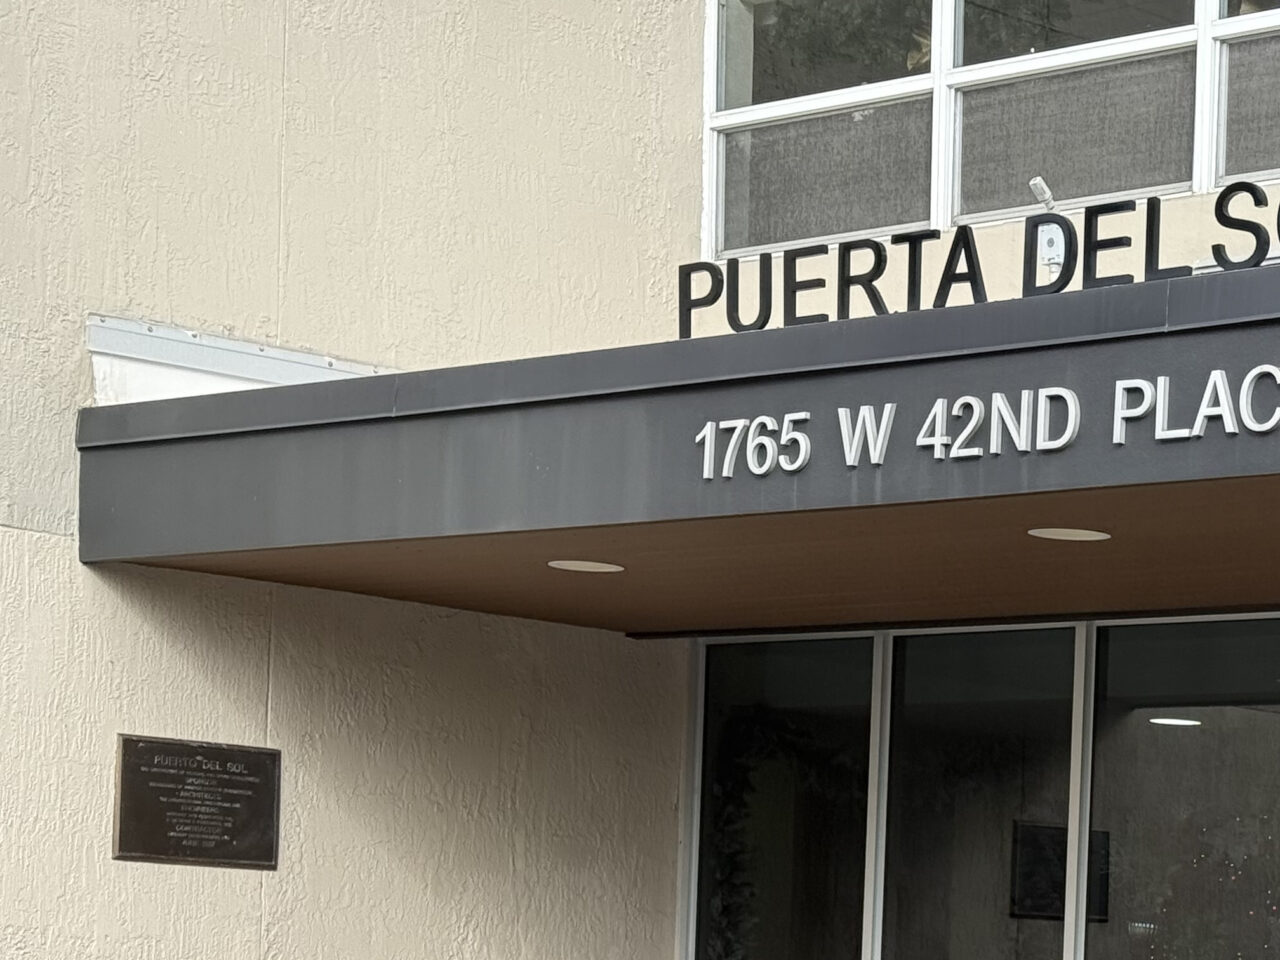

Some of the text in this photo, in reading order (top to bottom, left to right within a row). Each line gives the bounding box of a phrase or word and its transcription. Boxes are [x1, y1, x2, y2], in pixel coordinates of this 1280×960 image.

[678, 225, 989, 339] PUERTA
[1022, 196, 1194, 298] DEL
[695, 410, 812, 480] 1765
[837, 402, 896, 467] W
[916, 386, 1081, 460] 42ND
[202, 759, 223, 771] DEL
[226, 761, 249, 774] SOL
